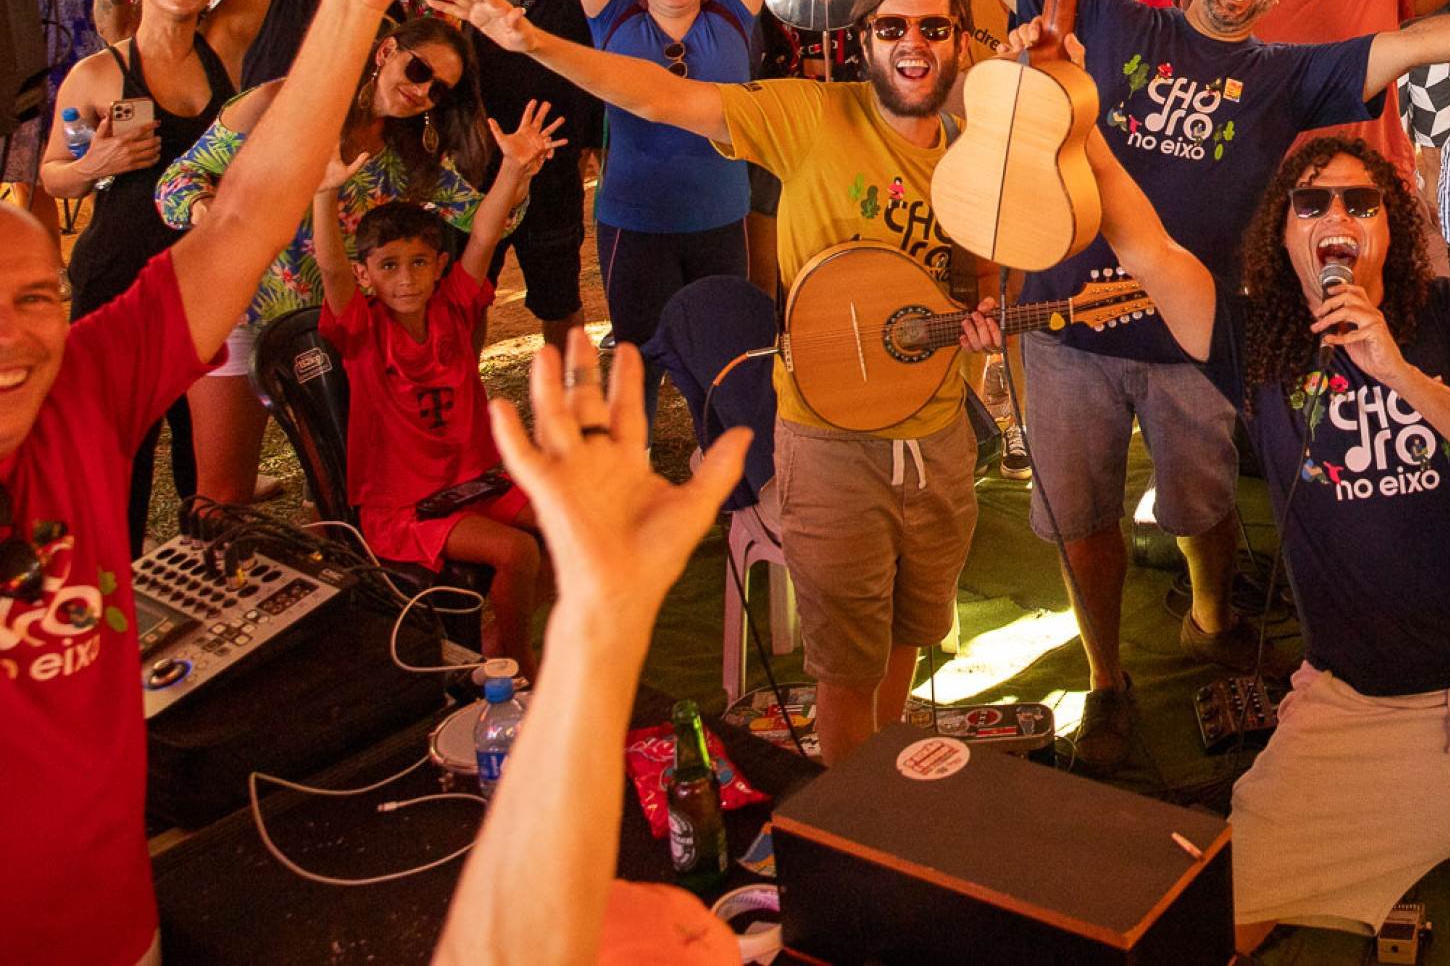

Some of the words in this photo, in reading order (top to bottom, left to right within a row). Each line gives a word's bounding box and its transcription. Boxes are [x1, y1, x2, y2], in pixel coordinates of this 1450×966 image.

[1127, 132, 1158, 150] no
[1160, 136, 1205, 160] eixo
[1335, 478, 1374, 501] no
[1379, 465, 1441, 497] eixo
